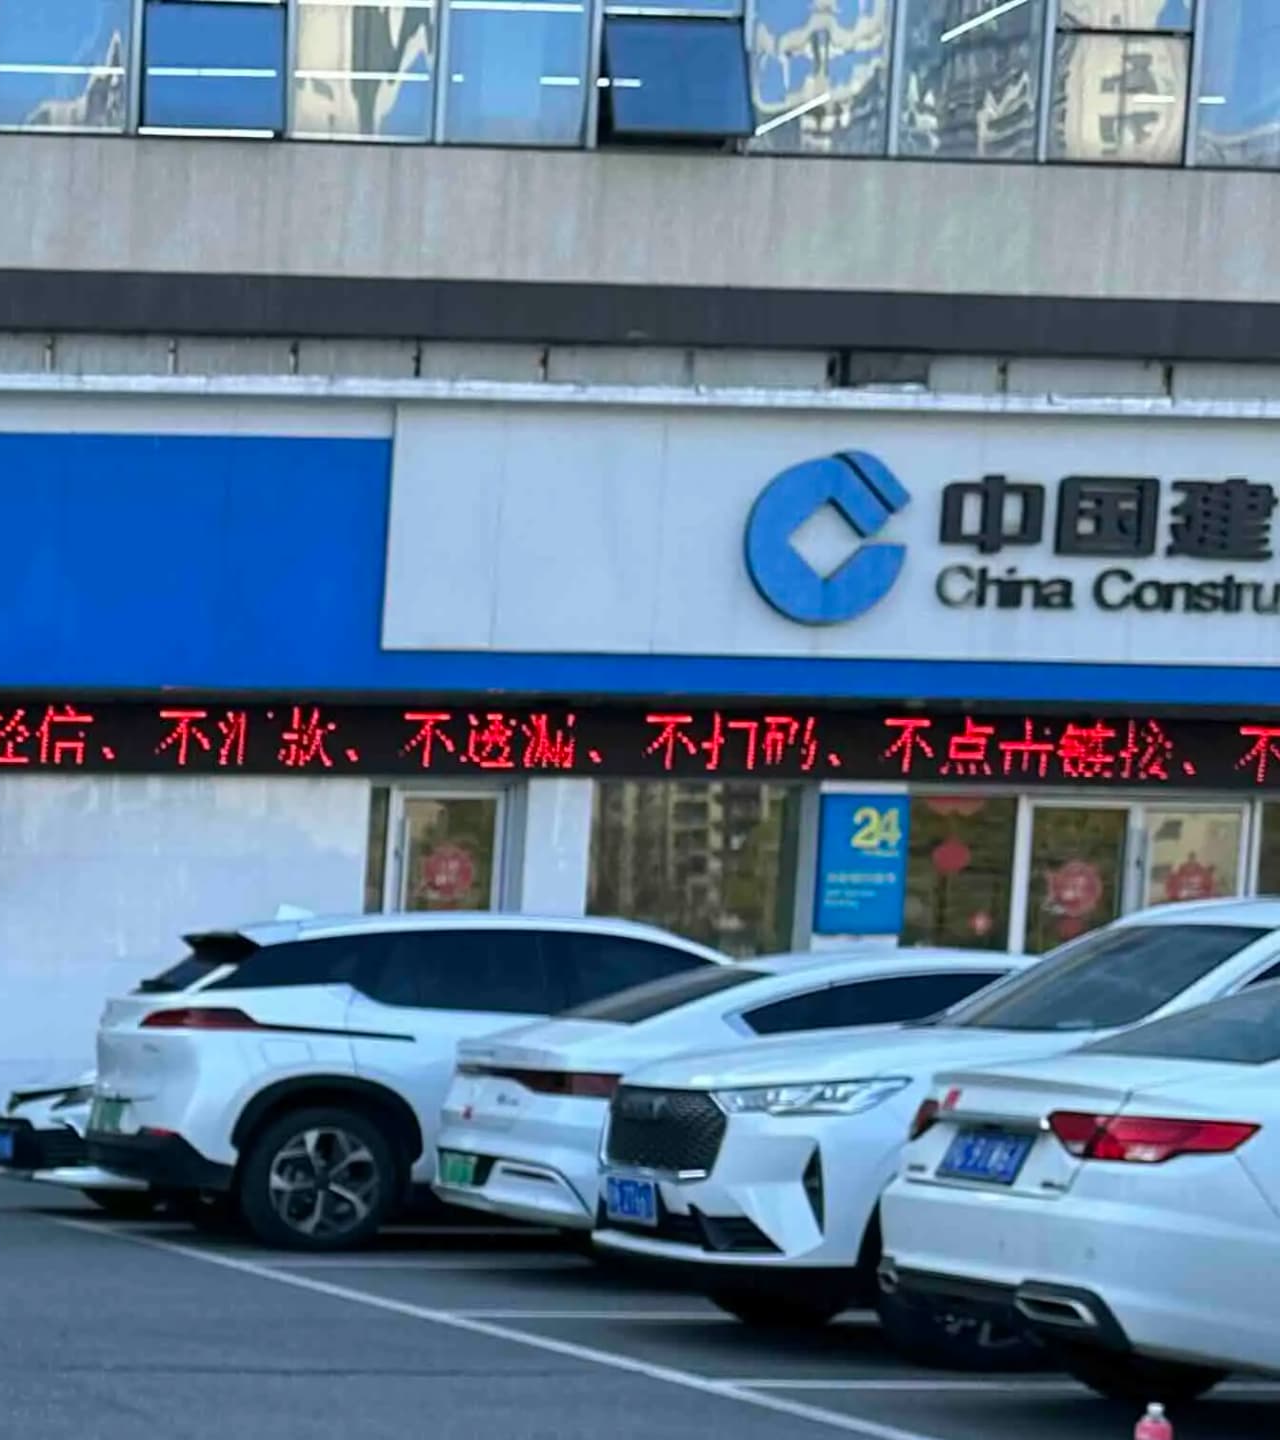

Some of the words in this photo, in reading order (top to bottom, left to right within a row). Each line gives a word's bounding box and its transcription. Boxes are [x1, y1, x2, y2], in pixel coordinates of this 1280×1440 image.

[938, 473, 1279, 561] 中国建
[935, 564, 1074, 610] China
[1093, 567, 1280, 613] Constru
[850, 806, 903, 850] 24
